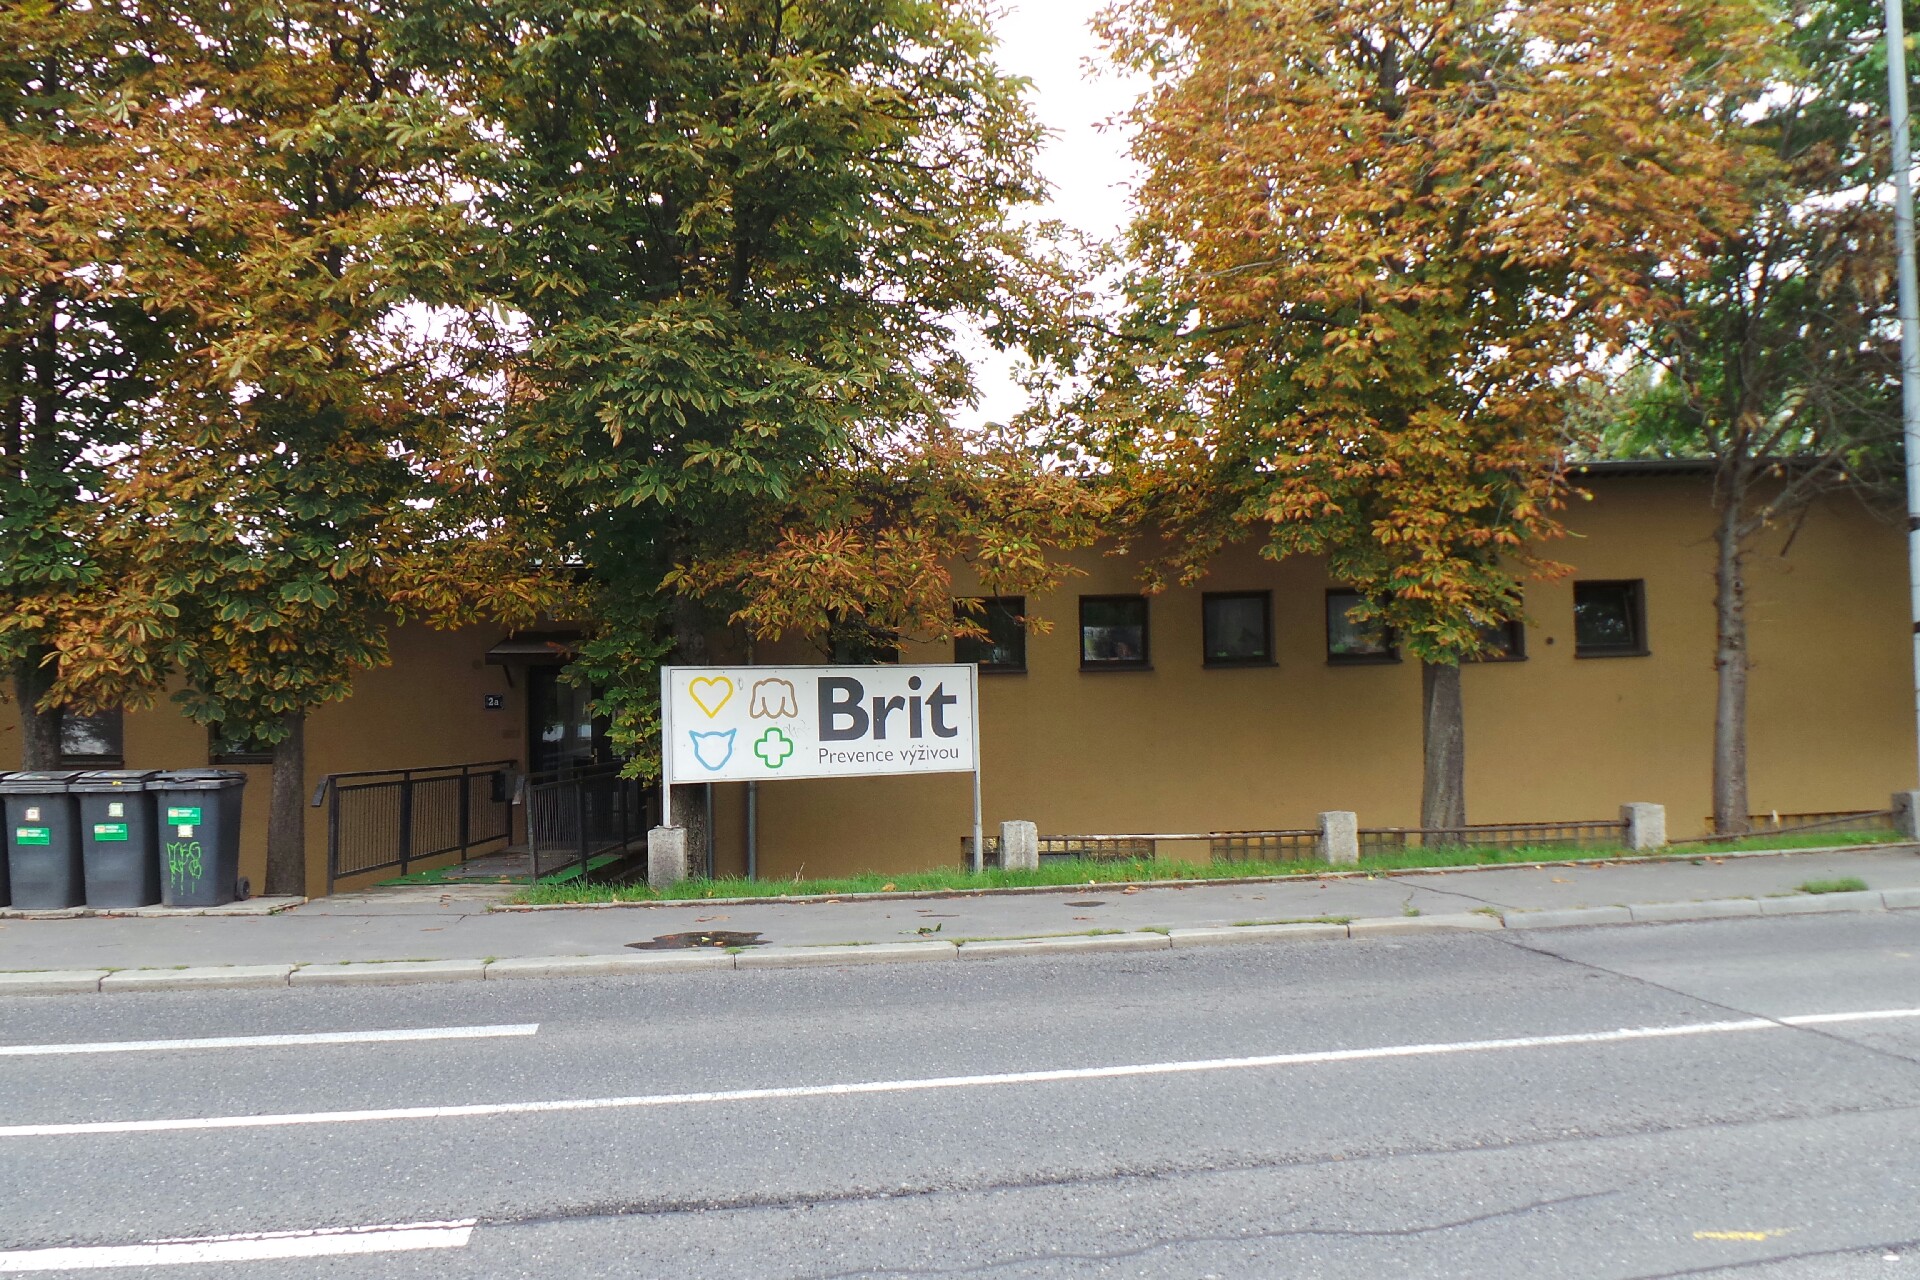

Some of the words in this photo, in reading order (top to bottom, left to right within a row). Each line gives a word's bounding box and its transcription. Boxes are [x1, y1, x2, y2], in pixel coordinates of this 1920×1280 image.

[488, 697, 499, 706] 2a
[817, 675, 958, 742] Brit
[818, 747, 894, 764] Prevence
[899, 744, 959, 765] výživou
